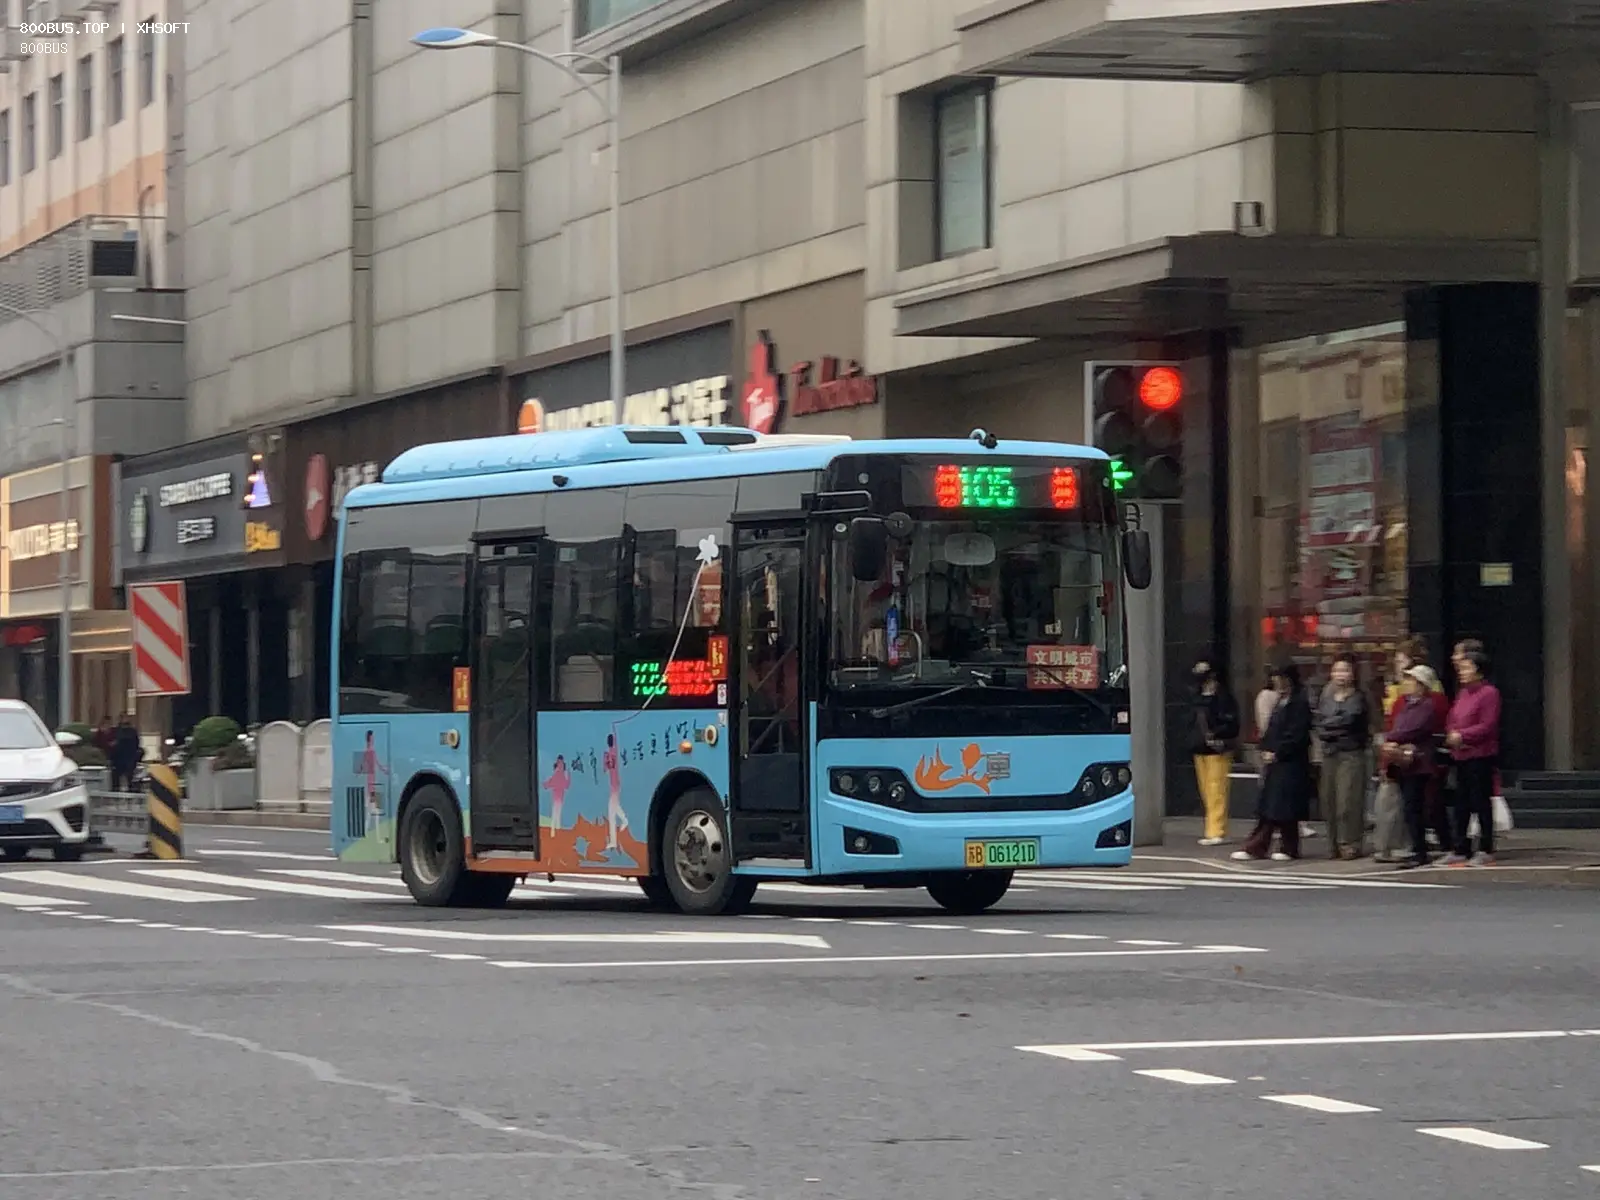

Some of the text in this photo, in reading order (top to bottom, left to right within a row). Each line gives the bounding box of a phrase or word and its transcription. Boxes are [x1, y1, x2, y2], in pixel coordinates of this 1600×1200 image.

[960, 466, 1015, 506] 105
[1033, 650, 1093, 665] 文明城市
